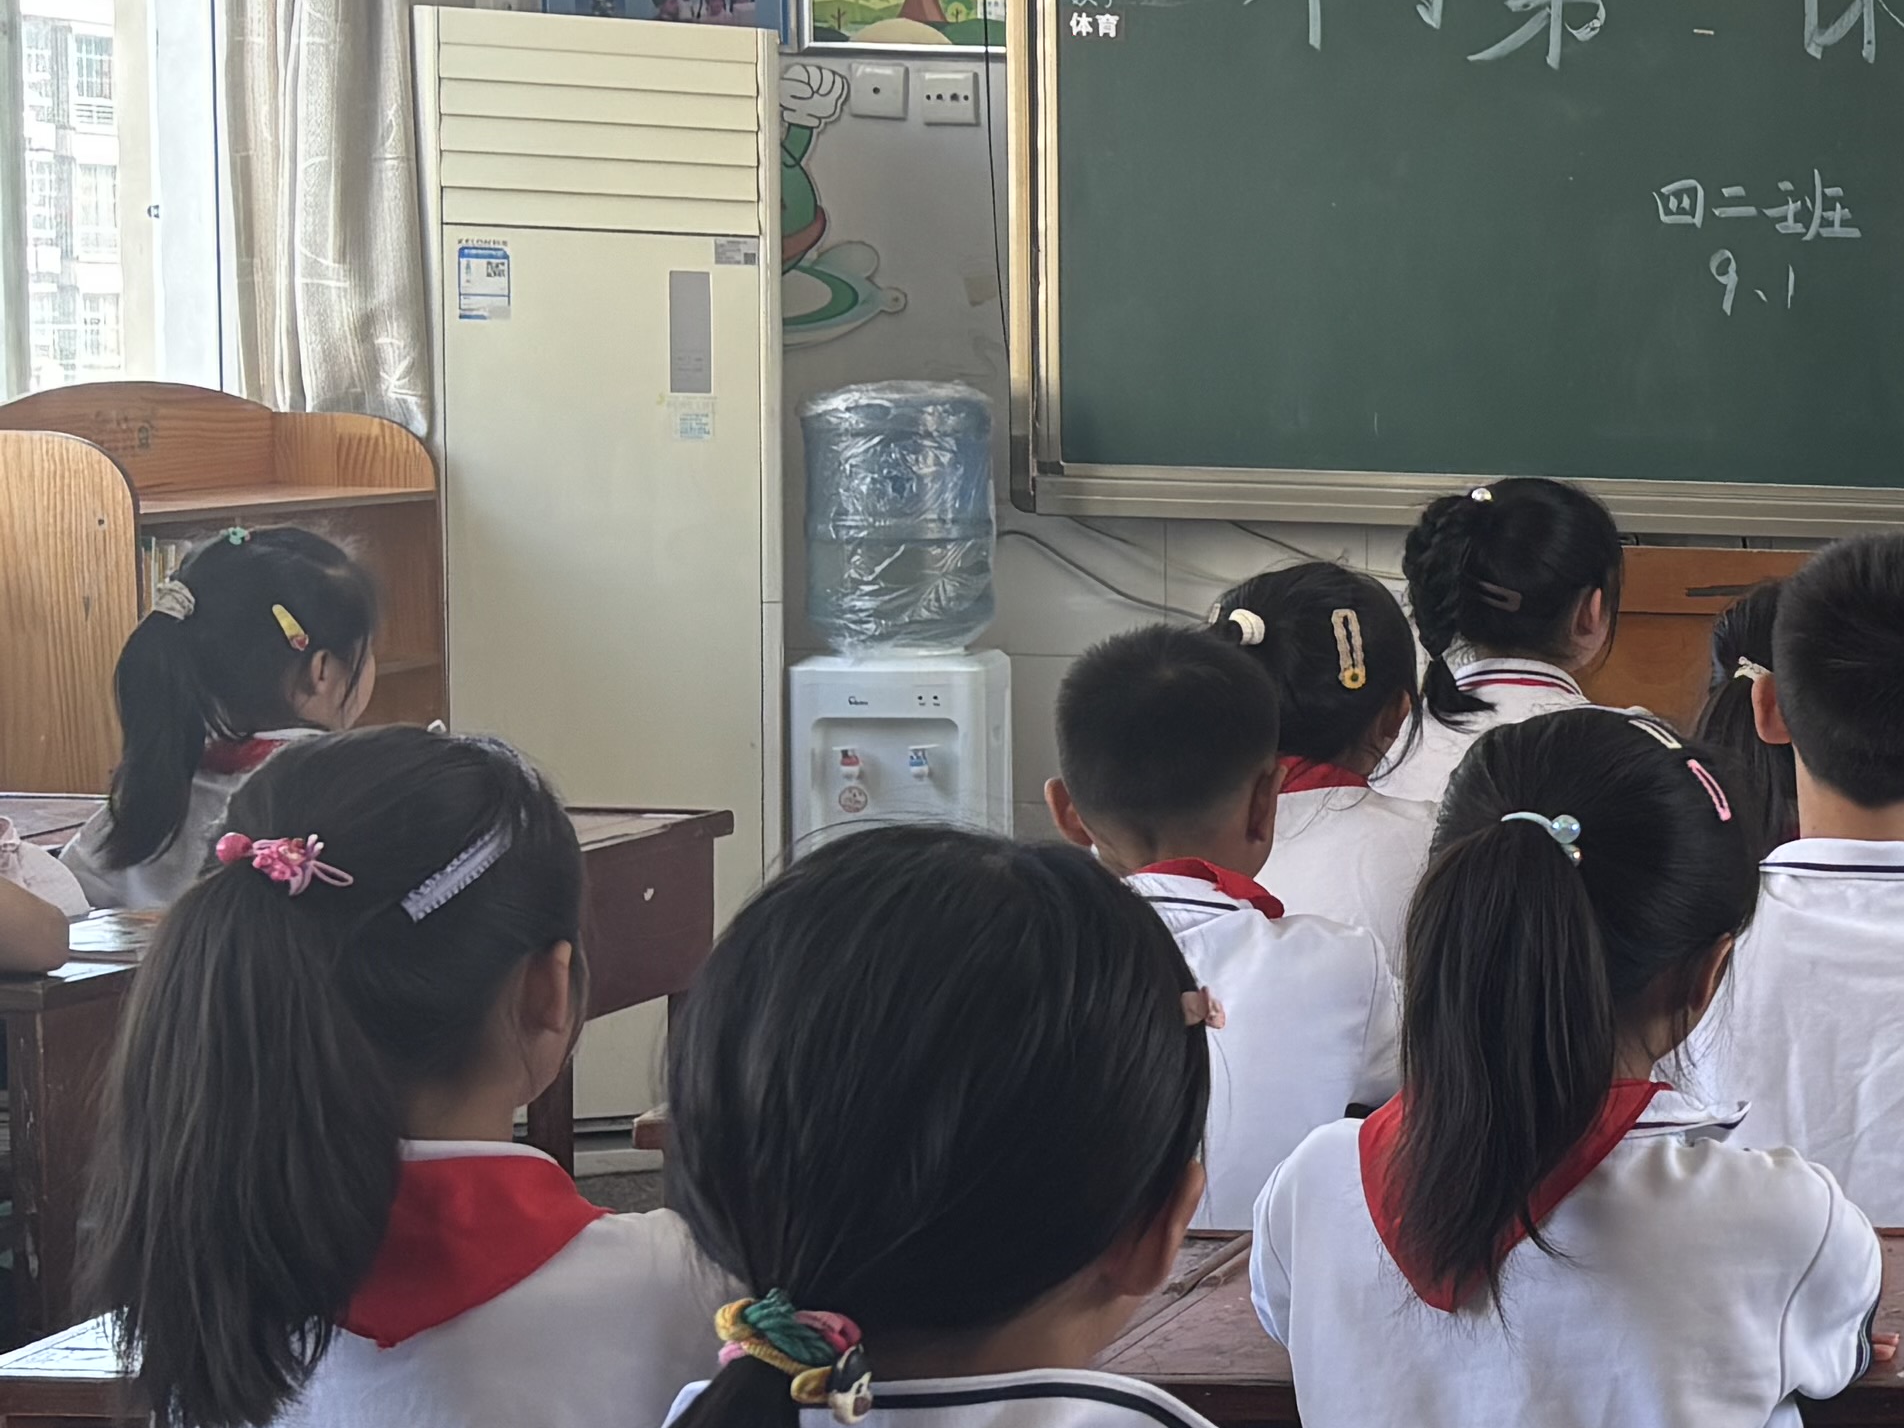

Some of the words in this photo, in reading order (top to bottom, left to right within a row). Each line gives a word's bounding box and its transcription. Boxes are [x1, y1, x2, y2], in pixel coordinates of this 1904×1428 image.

[1069, 12, 1120, 38] 体育
[1652, 169, 1862, 241] 四二班
